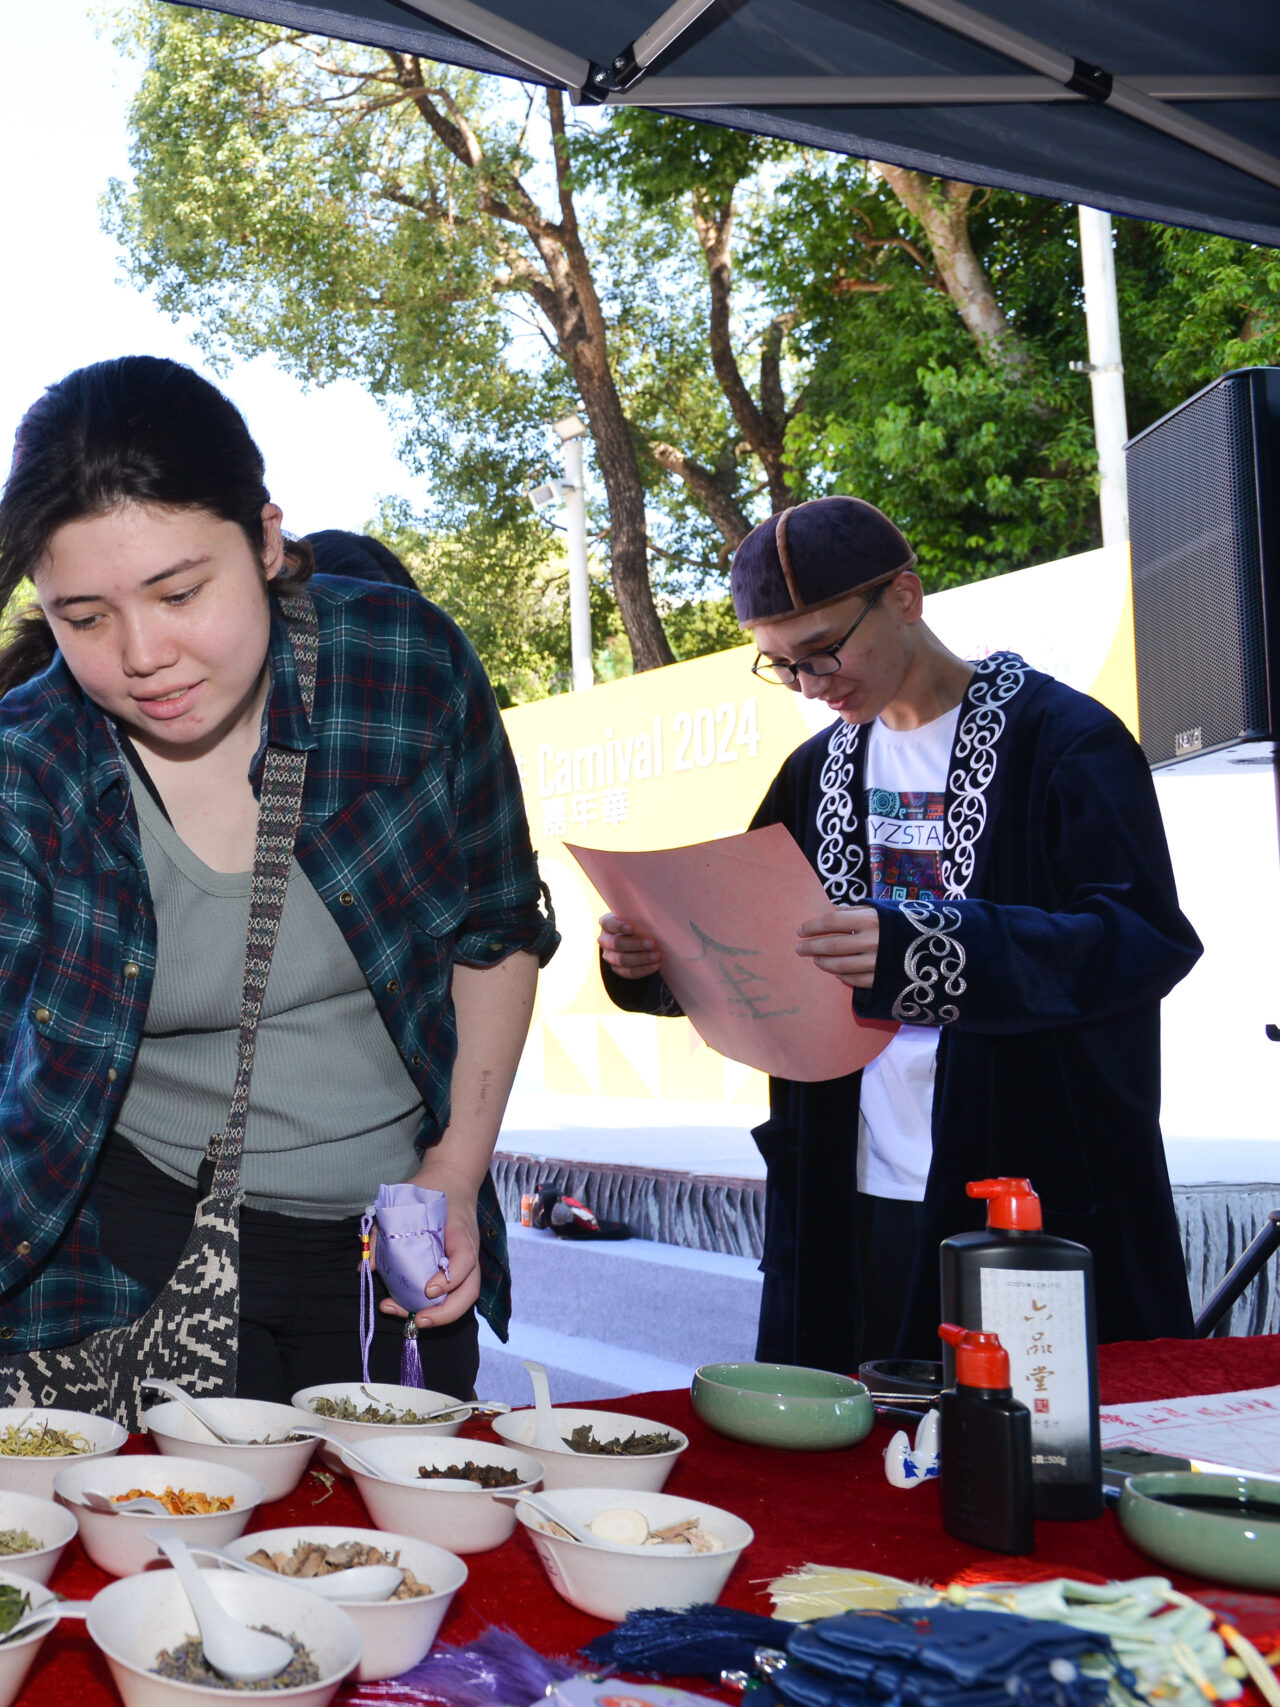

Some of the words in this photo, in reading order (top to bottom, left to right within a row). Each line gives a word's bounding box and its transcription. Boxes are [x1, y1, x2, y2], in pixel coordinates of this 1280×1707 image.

[537, 714, 663, 798] Carnival
[673, 696, 760, 772] 2024
[541, 787, 629, 837] 嘉年華
